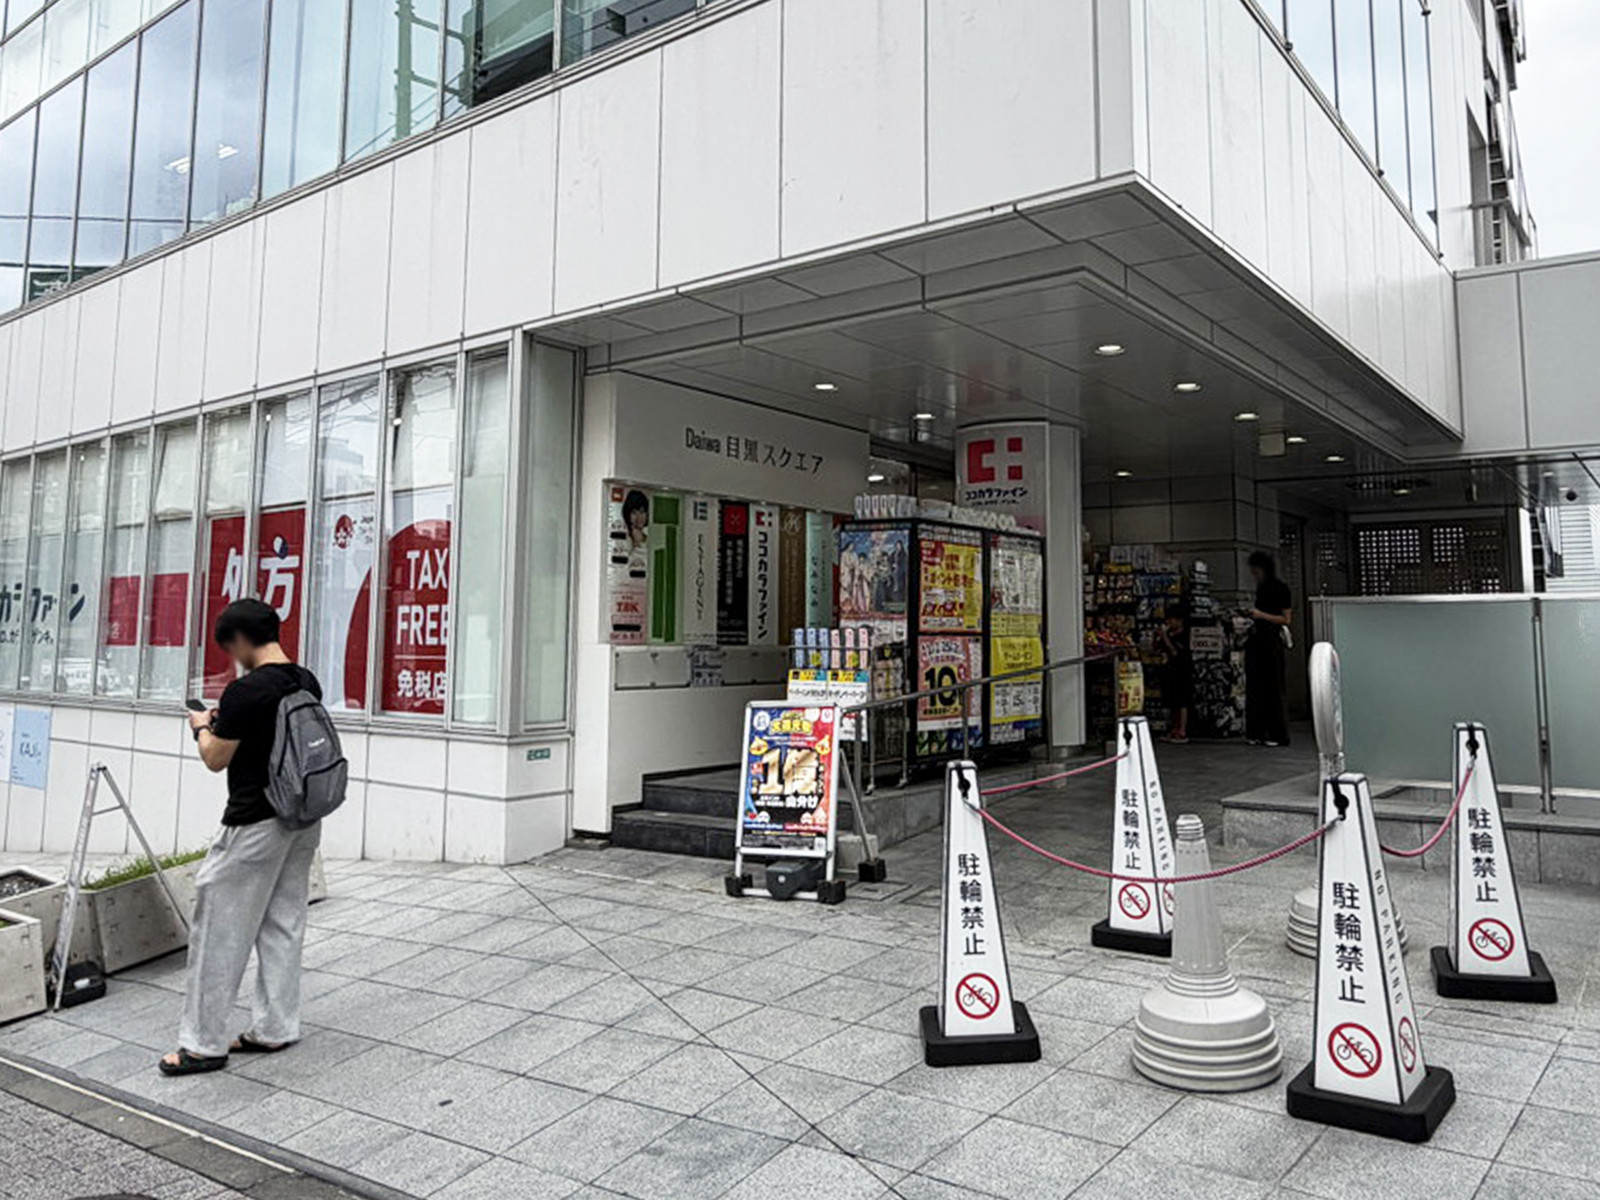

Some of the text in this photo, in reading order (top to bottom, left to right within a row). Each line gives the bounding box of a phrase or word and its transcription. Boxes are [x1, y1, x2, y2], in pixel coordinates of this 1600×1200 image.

[685, 427, 824, 475] Daiwa 目黒スクエア
[965, 487, 1029, 501] ココカラファイン
[406, 548, 450, 591] TAX
[757, 531, 769, 640] ココカラファイン
[397, 669, 449, 700] 免税店
[1121, 788, 1142, 871] 駐輪禁止
[1149, 780, 1171, 871] NO PARKING
[1467, 808, 1499, 903] 駐輪禁止
[957, 853, 987, 957] 駐輪禁止
[1332, 881, 1366, 1005] 駐輪禁止
[1374, 869, 1404, 1006] NO PARKING
